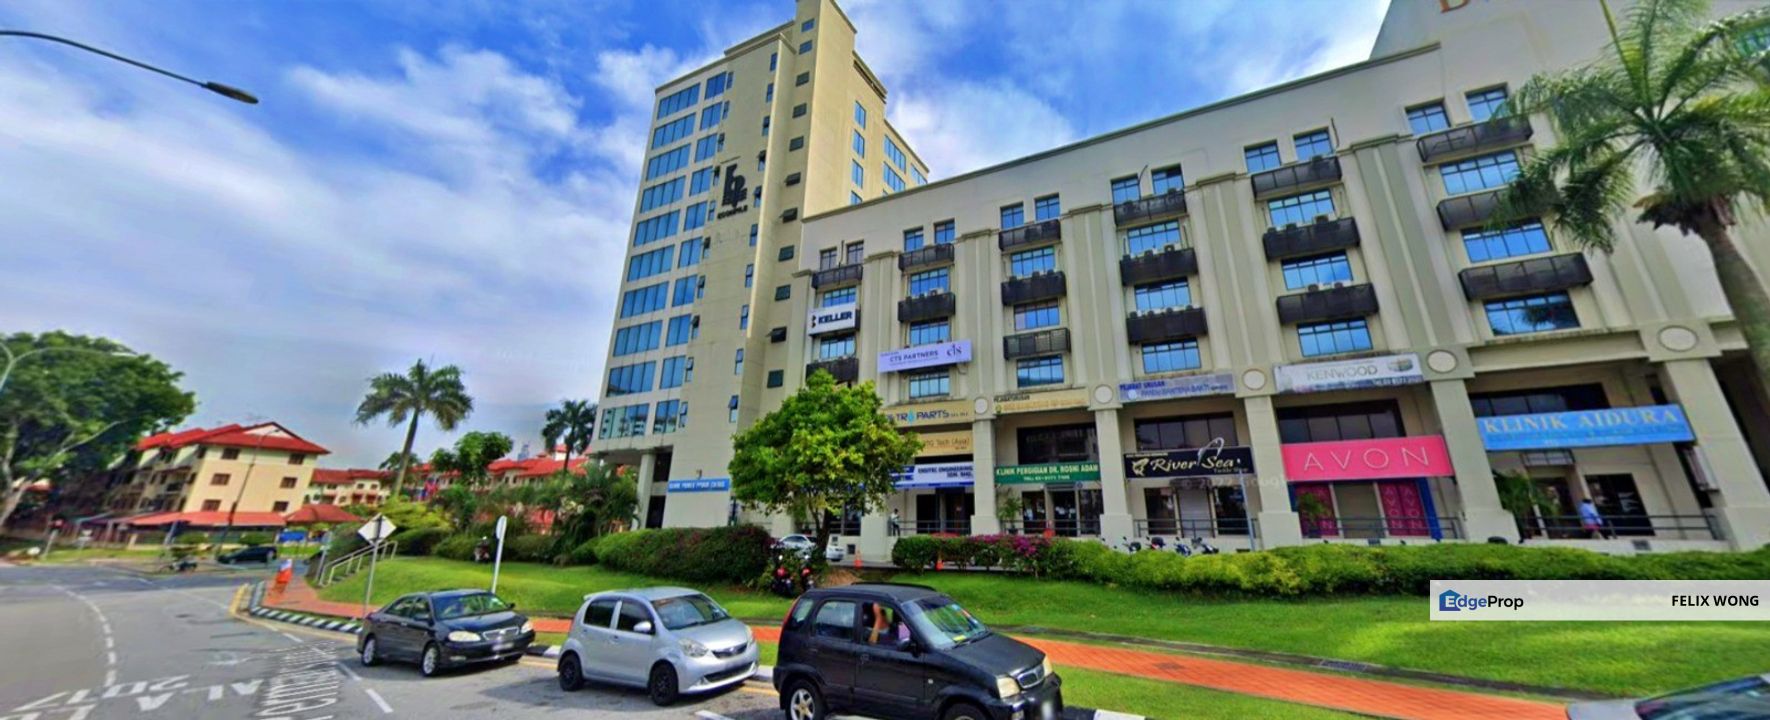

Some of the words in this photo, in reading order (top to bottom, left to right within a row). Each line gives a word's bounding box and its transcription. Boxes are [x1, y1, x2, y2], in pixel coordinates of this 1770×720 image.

[818, 311, 853, 324] KELLER
[903, 350, 939, 360] PARTNERS
[1305, 364, 1379, 381] KENWOOD
[1484, 413, 1568, 433] KLINIK
[1150, 457, 1198, 473] River
[1200, 455, 1234, 470] Sea
[1304, 446, 1429, 471] AVON
